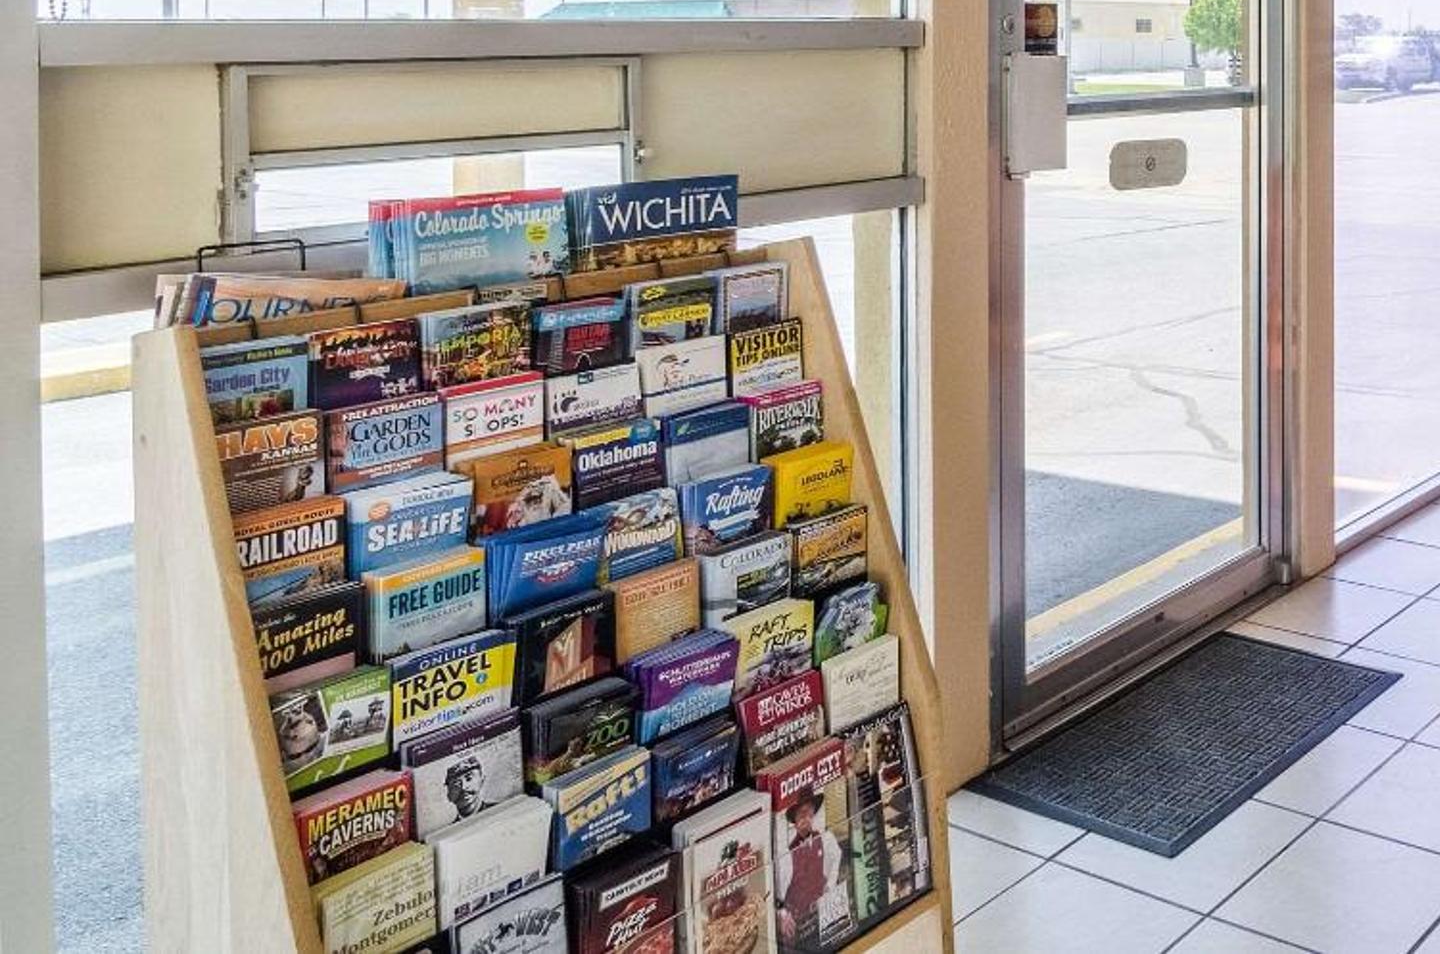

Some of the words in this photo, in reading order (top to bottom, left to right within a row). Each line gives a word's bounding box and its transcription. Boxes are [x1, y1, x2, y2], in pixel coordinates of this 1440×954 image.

[415, 206, 489, 237] Colorado
[491, 203, 565, 234] Springs
[598, 193, 732, 235] WICHITA
[736, 328, 799, 355] VISITOR
[737, 352, 759, 367] TIPS
[762, 343, 800, 360] ONLINE
[261, 366, 289, 384] City
[215, 417, 318, 461] HAYS
[350, 412, 431, 442] GARDEN
[373, 428, 431, 454] GODS
[465, 414, 524, 438] SOPS!
[579, 441, 657, 472] Oklahoma
[706, 485, 764, 515] Rafting
[237, 519, 337, 567] RAILROAD
[368, 520, 414, 553] SEA
[389, 584, 428, 619] FREE
[433, 568, 481, 604] GUIDE
[258, 607, 346, 651] Amazing
[302, 623, 354, 655] Miles
[749, 612, 792, 643] RAFT
[763, 624, 807, 653] TRIPS
[419, 642, 477, 670] ONLINE
[400, 653, 491, 697] TRAVEL
[308, 784, 408, 845] MERAMEC
[319, 810, 396, 856] CAVERNS
